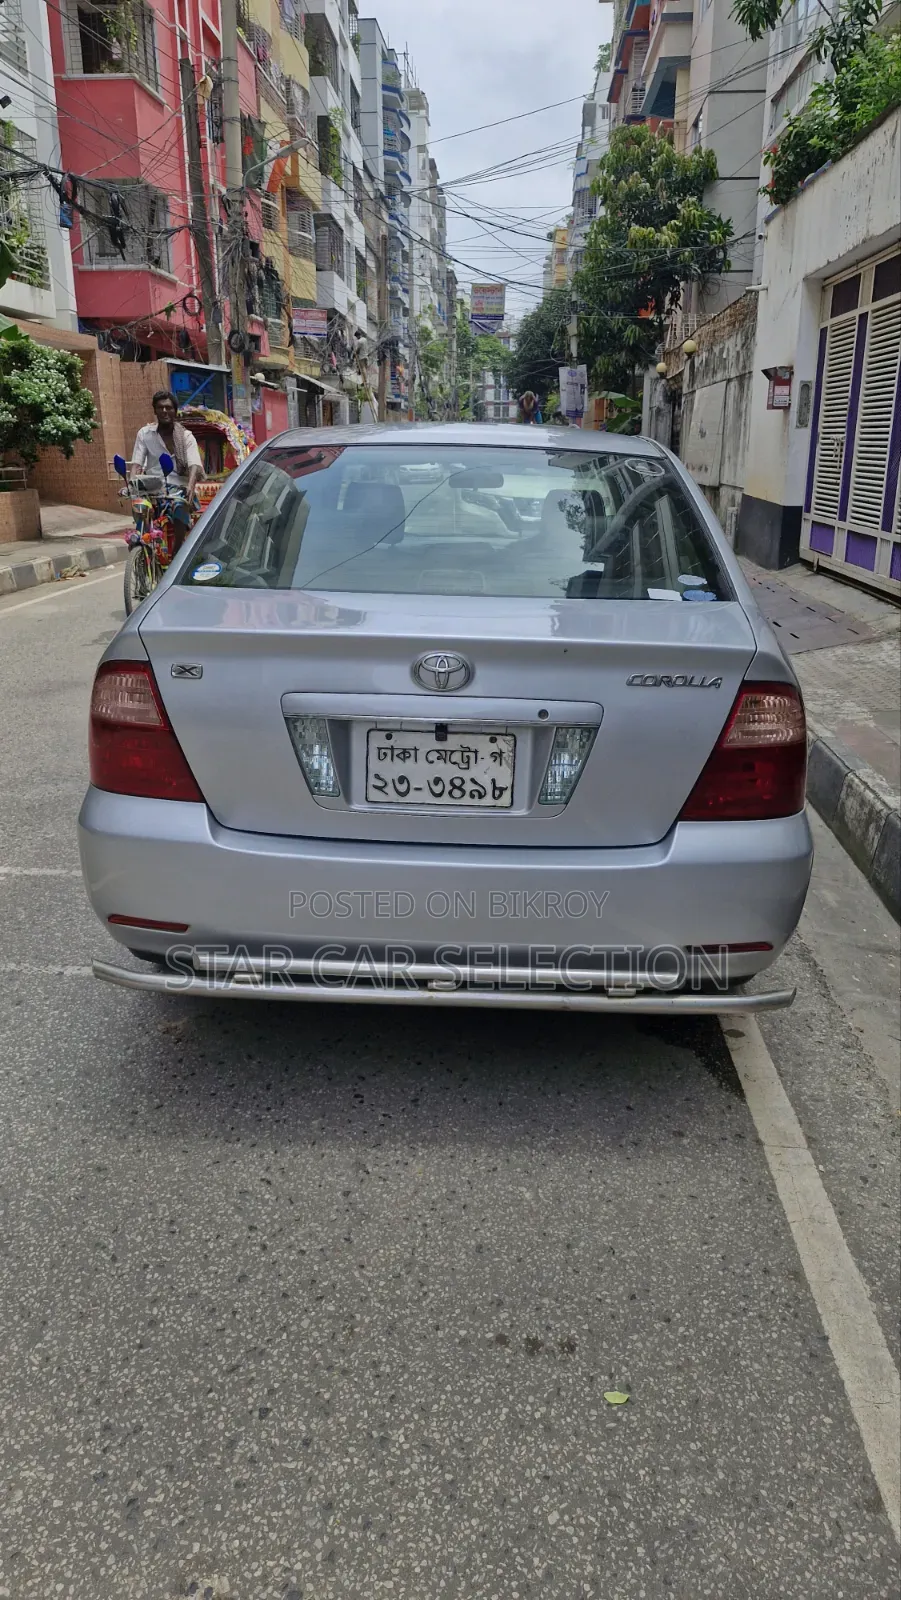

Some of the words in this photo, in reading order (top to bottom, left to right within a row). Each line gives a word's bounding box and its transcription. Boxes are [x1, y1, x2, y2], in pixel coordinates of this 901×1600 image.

[626, 673, 723, 688] COROLLA
[377, 745, 420, 763] ঢাকা
[372, 773, 509, 801] ২৩-৩৪৯৮
